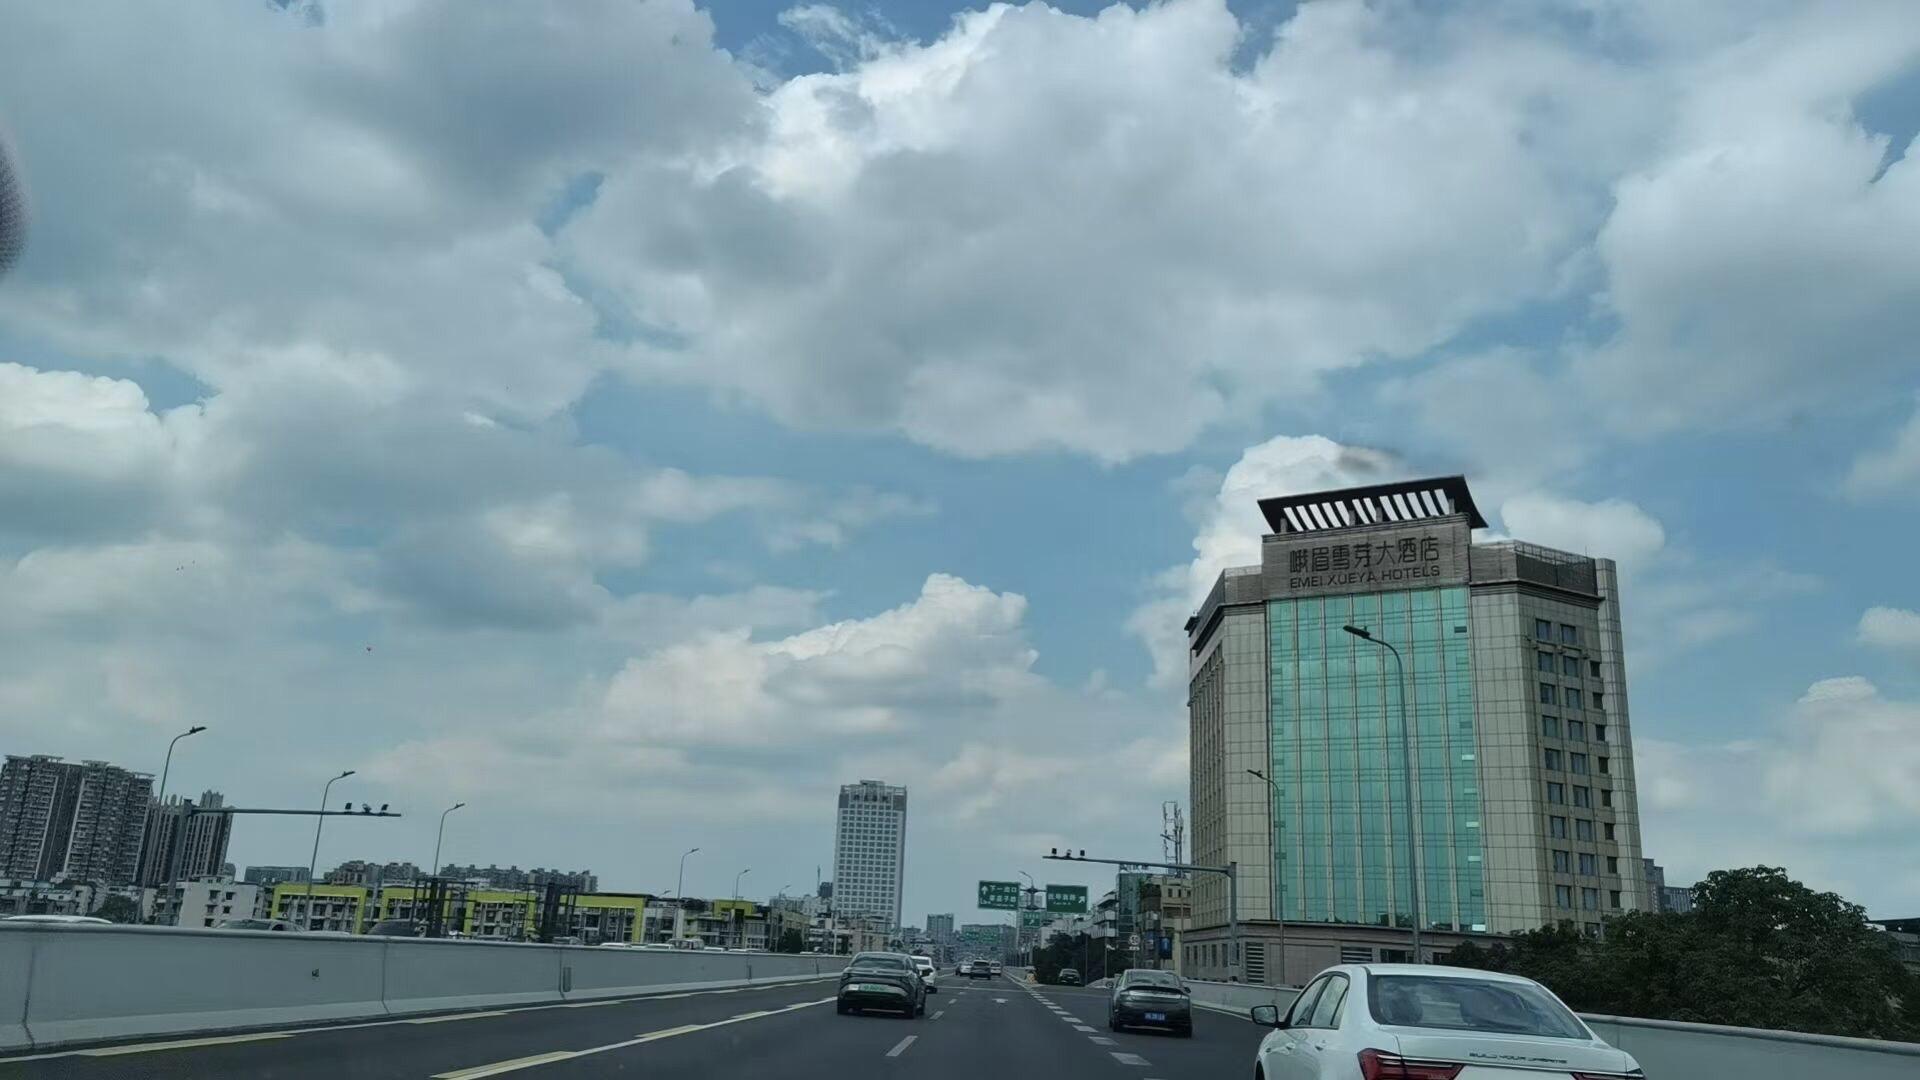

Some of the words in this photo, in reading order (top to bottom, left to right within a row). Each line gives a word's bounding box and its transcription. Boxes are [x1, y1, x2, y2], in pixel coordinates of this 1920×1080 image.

[1289, 536, 1440, 574] 峨眉雪芽大酒店
[1290, 574, 1323, 589] EMEI
[1327, 570, 1377, 586] XUEYA
[1382, 565, 1441, 581] HOTELS
